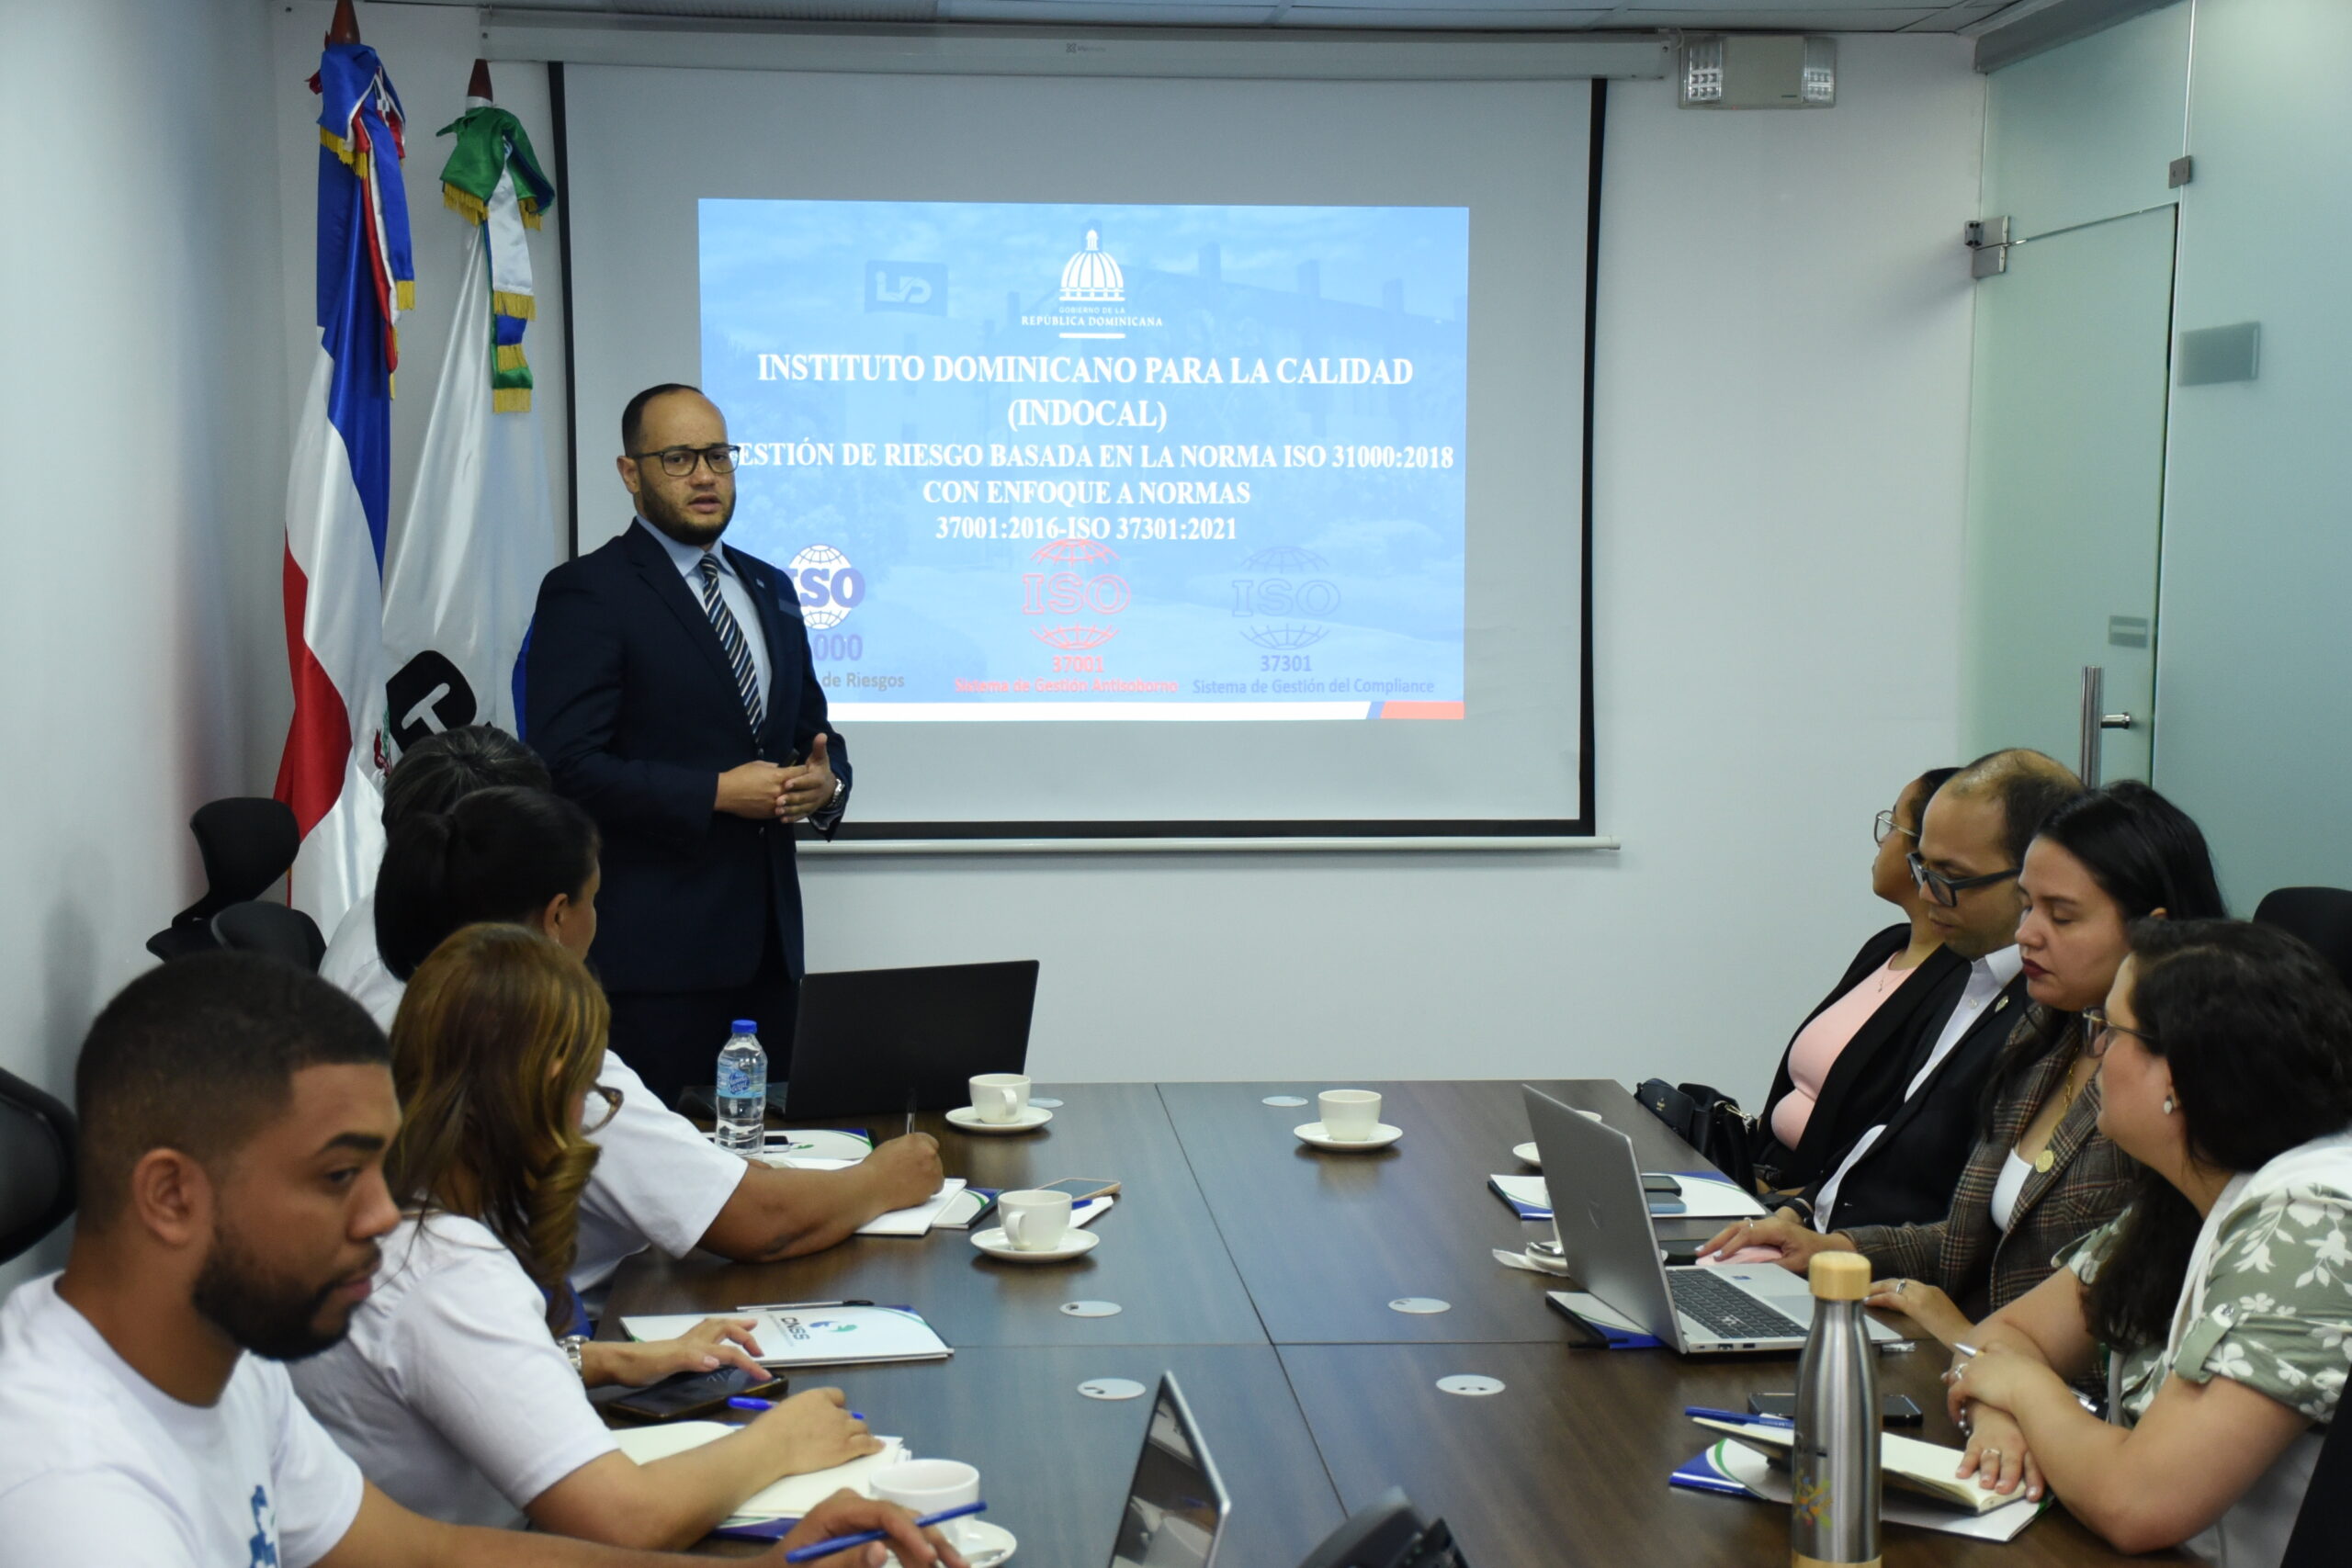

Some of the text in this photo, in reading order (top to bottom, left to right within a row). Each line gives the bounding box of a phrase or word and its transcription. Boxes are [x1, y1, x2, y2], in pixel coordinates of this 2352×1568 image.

[1058, 306, 1100, 314] GOBIERNO
[1088, 316, 1163, 327] DOMINICANA
[757, 353, 1414, 385] INSTITUTO DOMINICANO PARA LA CALIDAD
[1008, 399, 1167, 433] (INDOCAL)
[842, 444, 877, 467] DE
[884, 444, 983, 468] RIESGO
[990, 445, 1094, 468] BASADA
[1099, 445, 1134, 468] EN
[1140, 446, 1176, 468] LA
[1180, 446, 1277, 468] NORMA
[1285, 446, 1327, 468] ISO
[1331, 446, 1454, 468] 31000:2018
[922, 479, 1250, 508] CON ENFOQUE A NORMAS
[935, 515, 1237, 540] 37001:2016-ISO 37301:2021
[1022, 571, 1132, 615] ISO
[1230, 578, 1341, 617] ISO
[812, 633, 863, 661] 000
[1052, 655, 1104, 673] 37001
[1260, 655, 1313, 672] 37301
[821, 671, 904, 692] de Riesgos
[955, 677, 1179, 694] Sistema de Gestión Antisoborno
[1193, 678, 1435, 696] Sistema de Gestión del Compliance
[779, 1316, 811, 1341] CNSS
